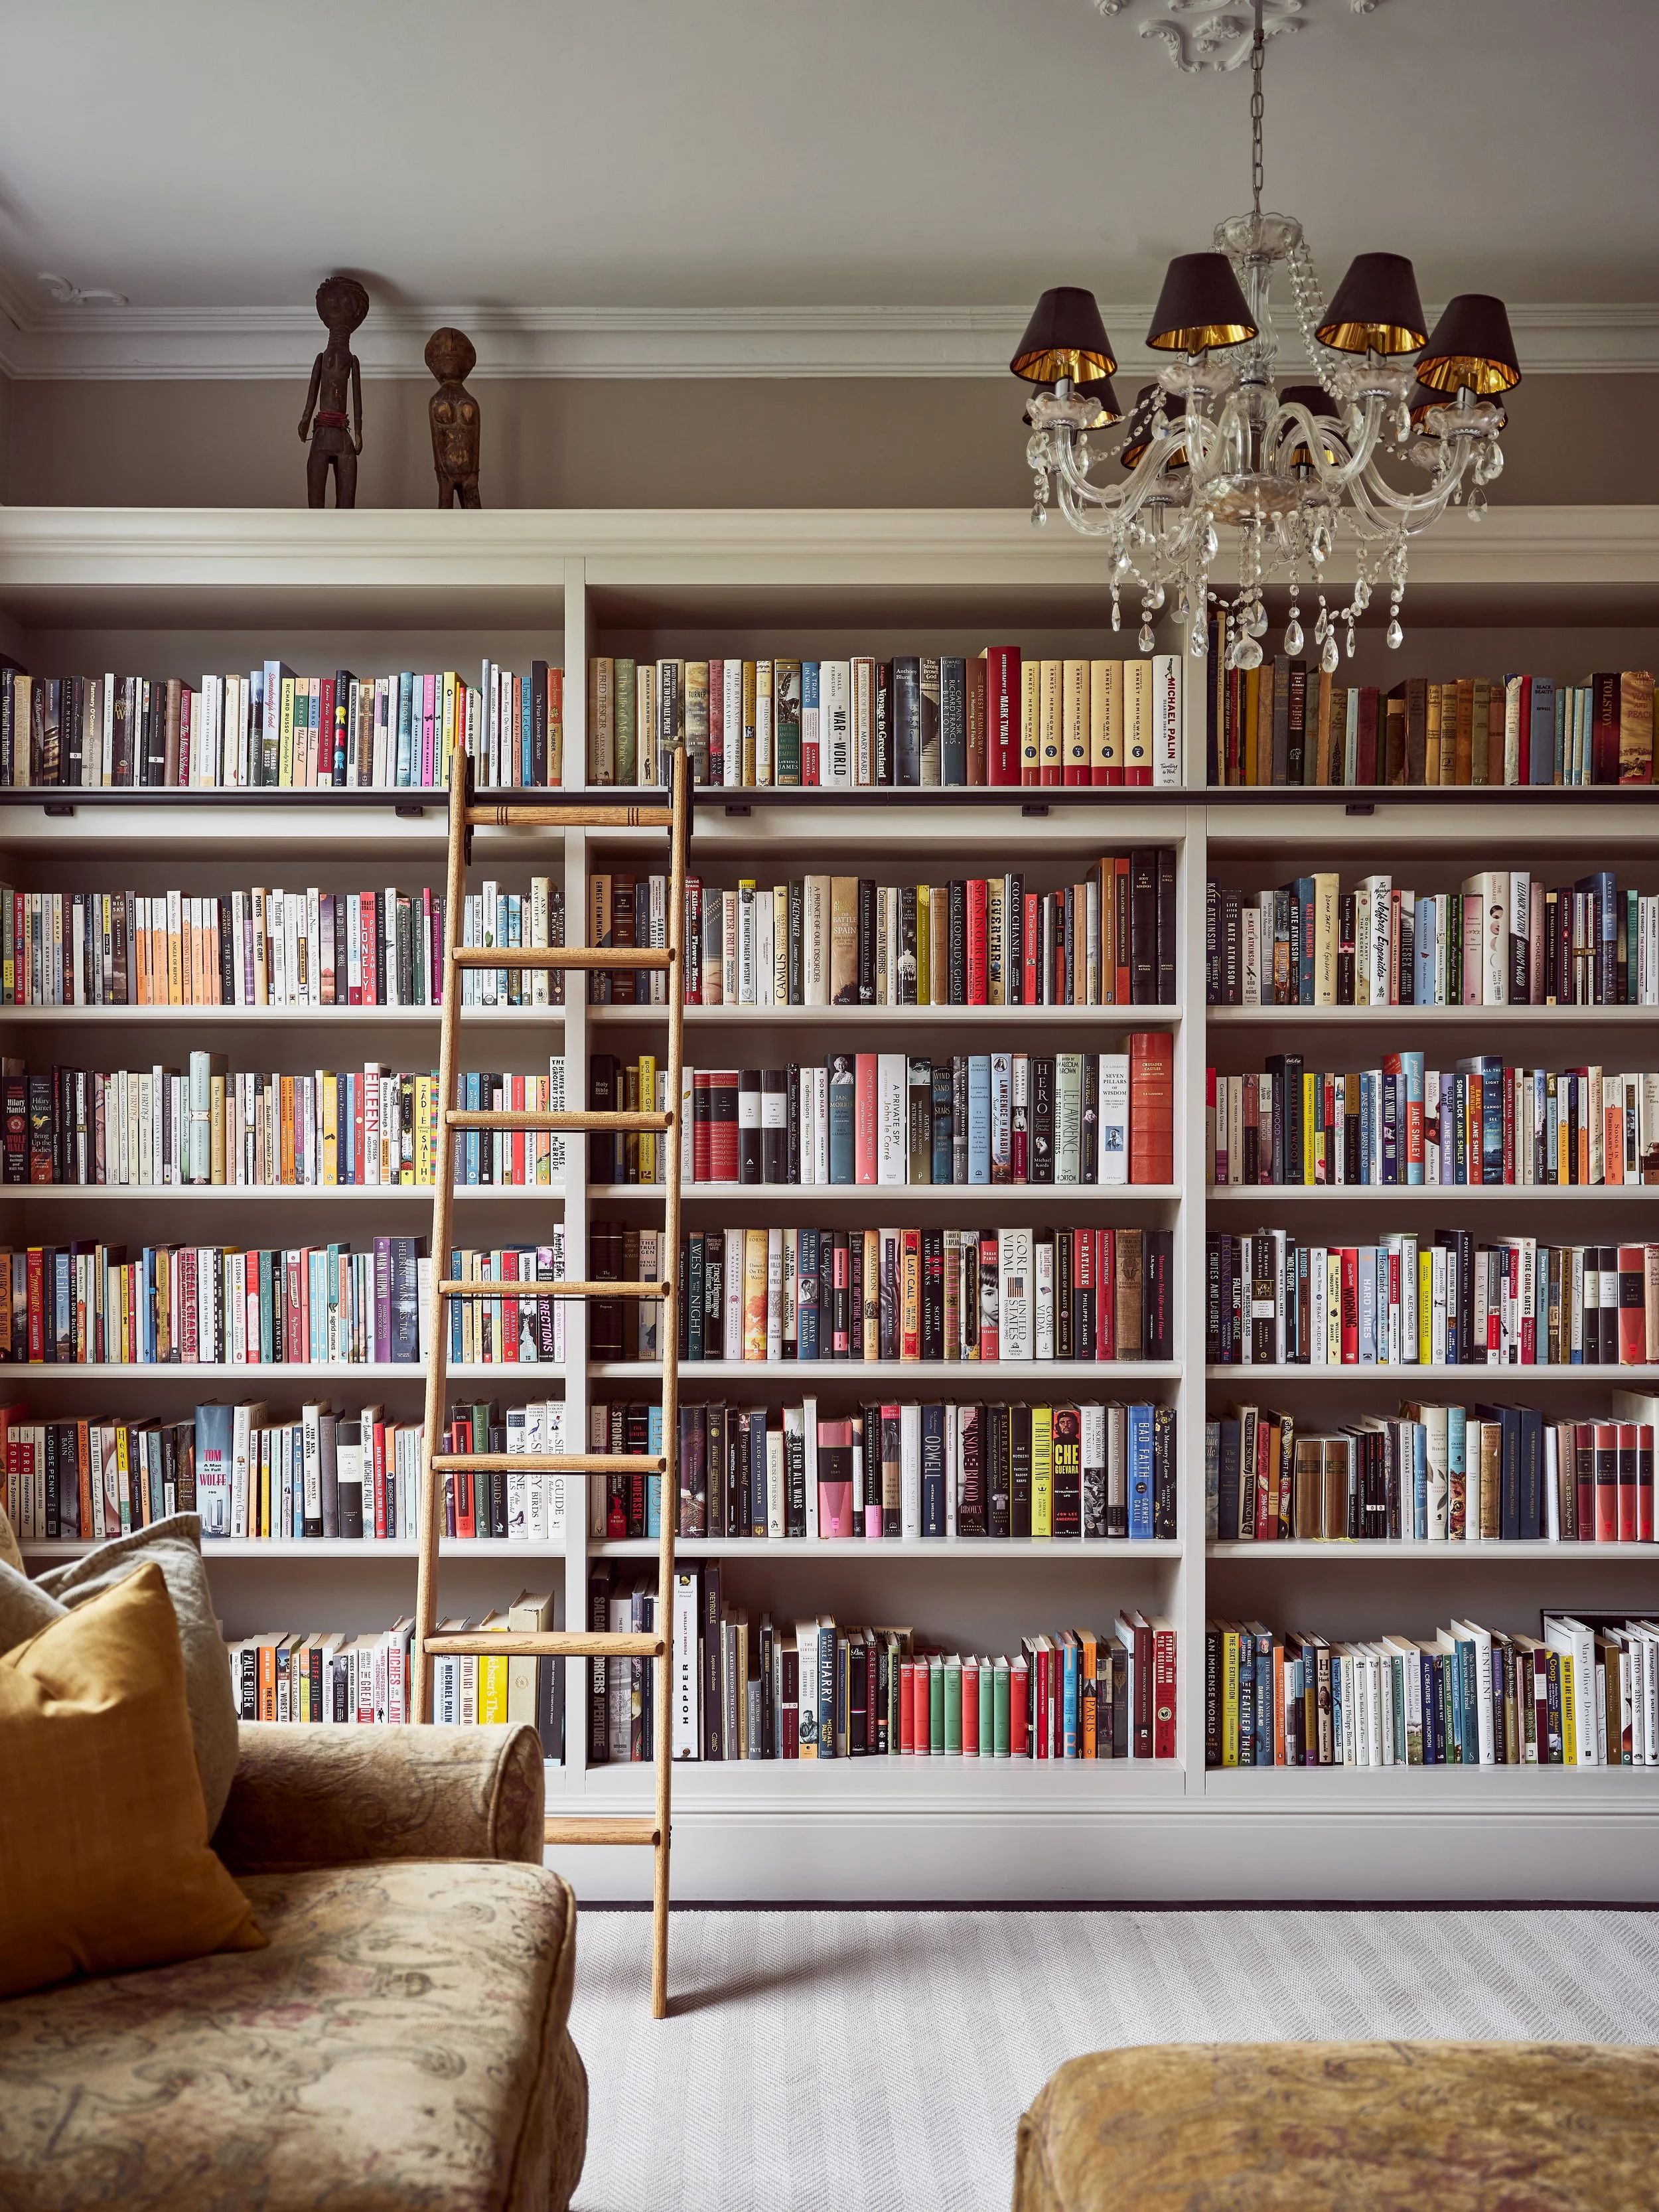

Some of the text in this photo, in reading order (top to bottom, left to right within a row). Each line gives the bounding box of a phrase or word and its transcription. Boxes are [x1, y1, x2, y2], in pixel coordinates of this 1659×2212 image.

[265, 672, 276, 711] Somebody's
[1000, 696, 1009, 718] MARK
[1603, 679, 1613, 727] TOLSTOY
[618, 674, 628, 765] The Life of My Choice
[833, 711, 846, 731] WAR
[1000, 719, 1009, 745] TWAIN
[833, 742, 846, 775] WORLD
[1517, 881, 1526, 934] ELEANOR CATTON
[1373, 901, 1390, 982] Jeffrey Eugenides
[1516, 939, 1526, 986] BIRNAM WOOD
[776, 954, 786, 999] CAMUS
[366, 1072, 378, 1132] EILEEN
[883, 1100, 892, 1122] John
[883, 1136, 892, 1160] Carré
[690, 1243, 701, 1278] WEST
[1003, 1234, 1013, 1275] VIDAL
[1017, 1234, 1027, 1275] GORE
[186, 1253, 196, 1353] MICHAEL CHABON
[690, 1295, 701, 1337] NIGHT
[1009, 1299, 1018, 1340] STATES
[1035, 1421, 1050, 1480] TRAITOR KING
[1139, 1423, 1149, 1477] BAD FAITH
[234, 1467, 246, 1520] Hemingway's Chair
[364, 1460, 372, 1509] MICHAEL PALIN
[792, 1441, 802, 1509] TO END ALL WARS
[1208, 1638, 1215, 1651] AN
[1581, 1643, 1590, 1664] Mary
[244, 1655, 253, 1708] PALE RIDER
[822, 1661, 832, 1704] HARRY
[1344, 1660, 1352, 1746] Nature's Mutiny Philipp Blom
[1086, 1700, 1096, 1732] PARIS
[1583, 1701, 1592, 1745] Devotions
